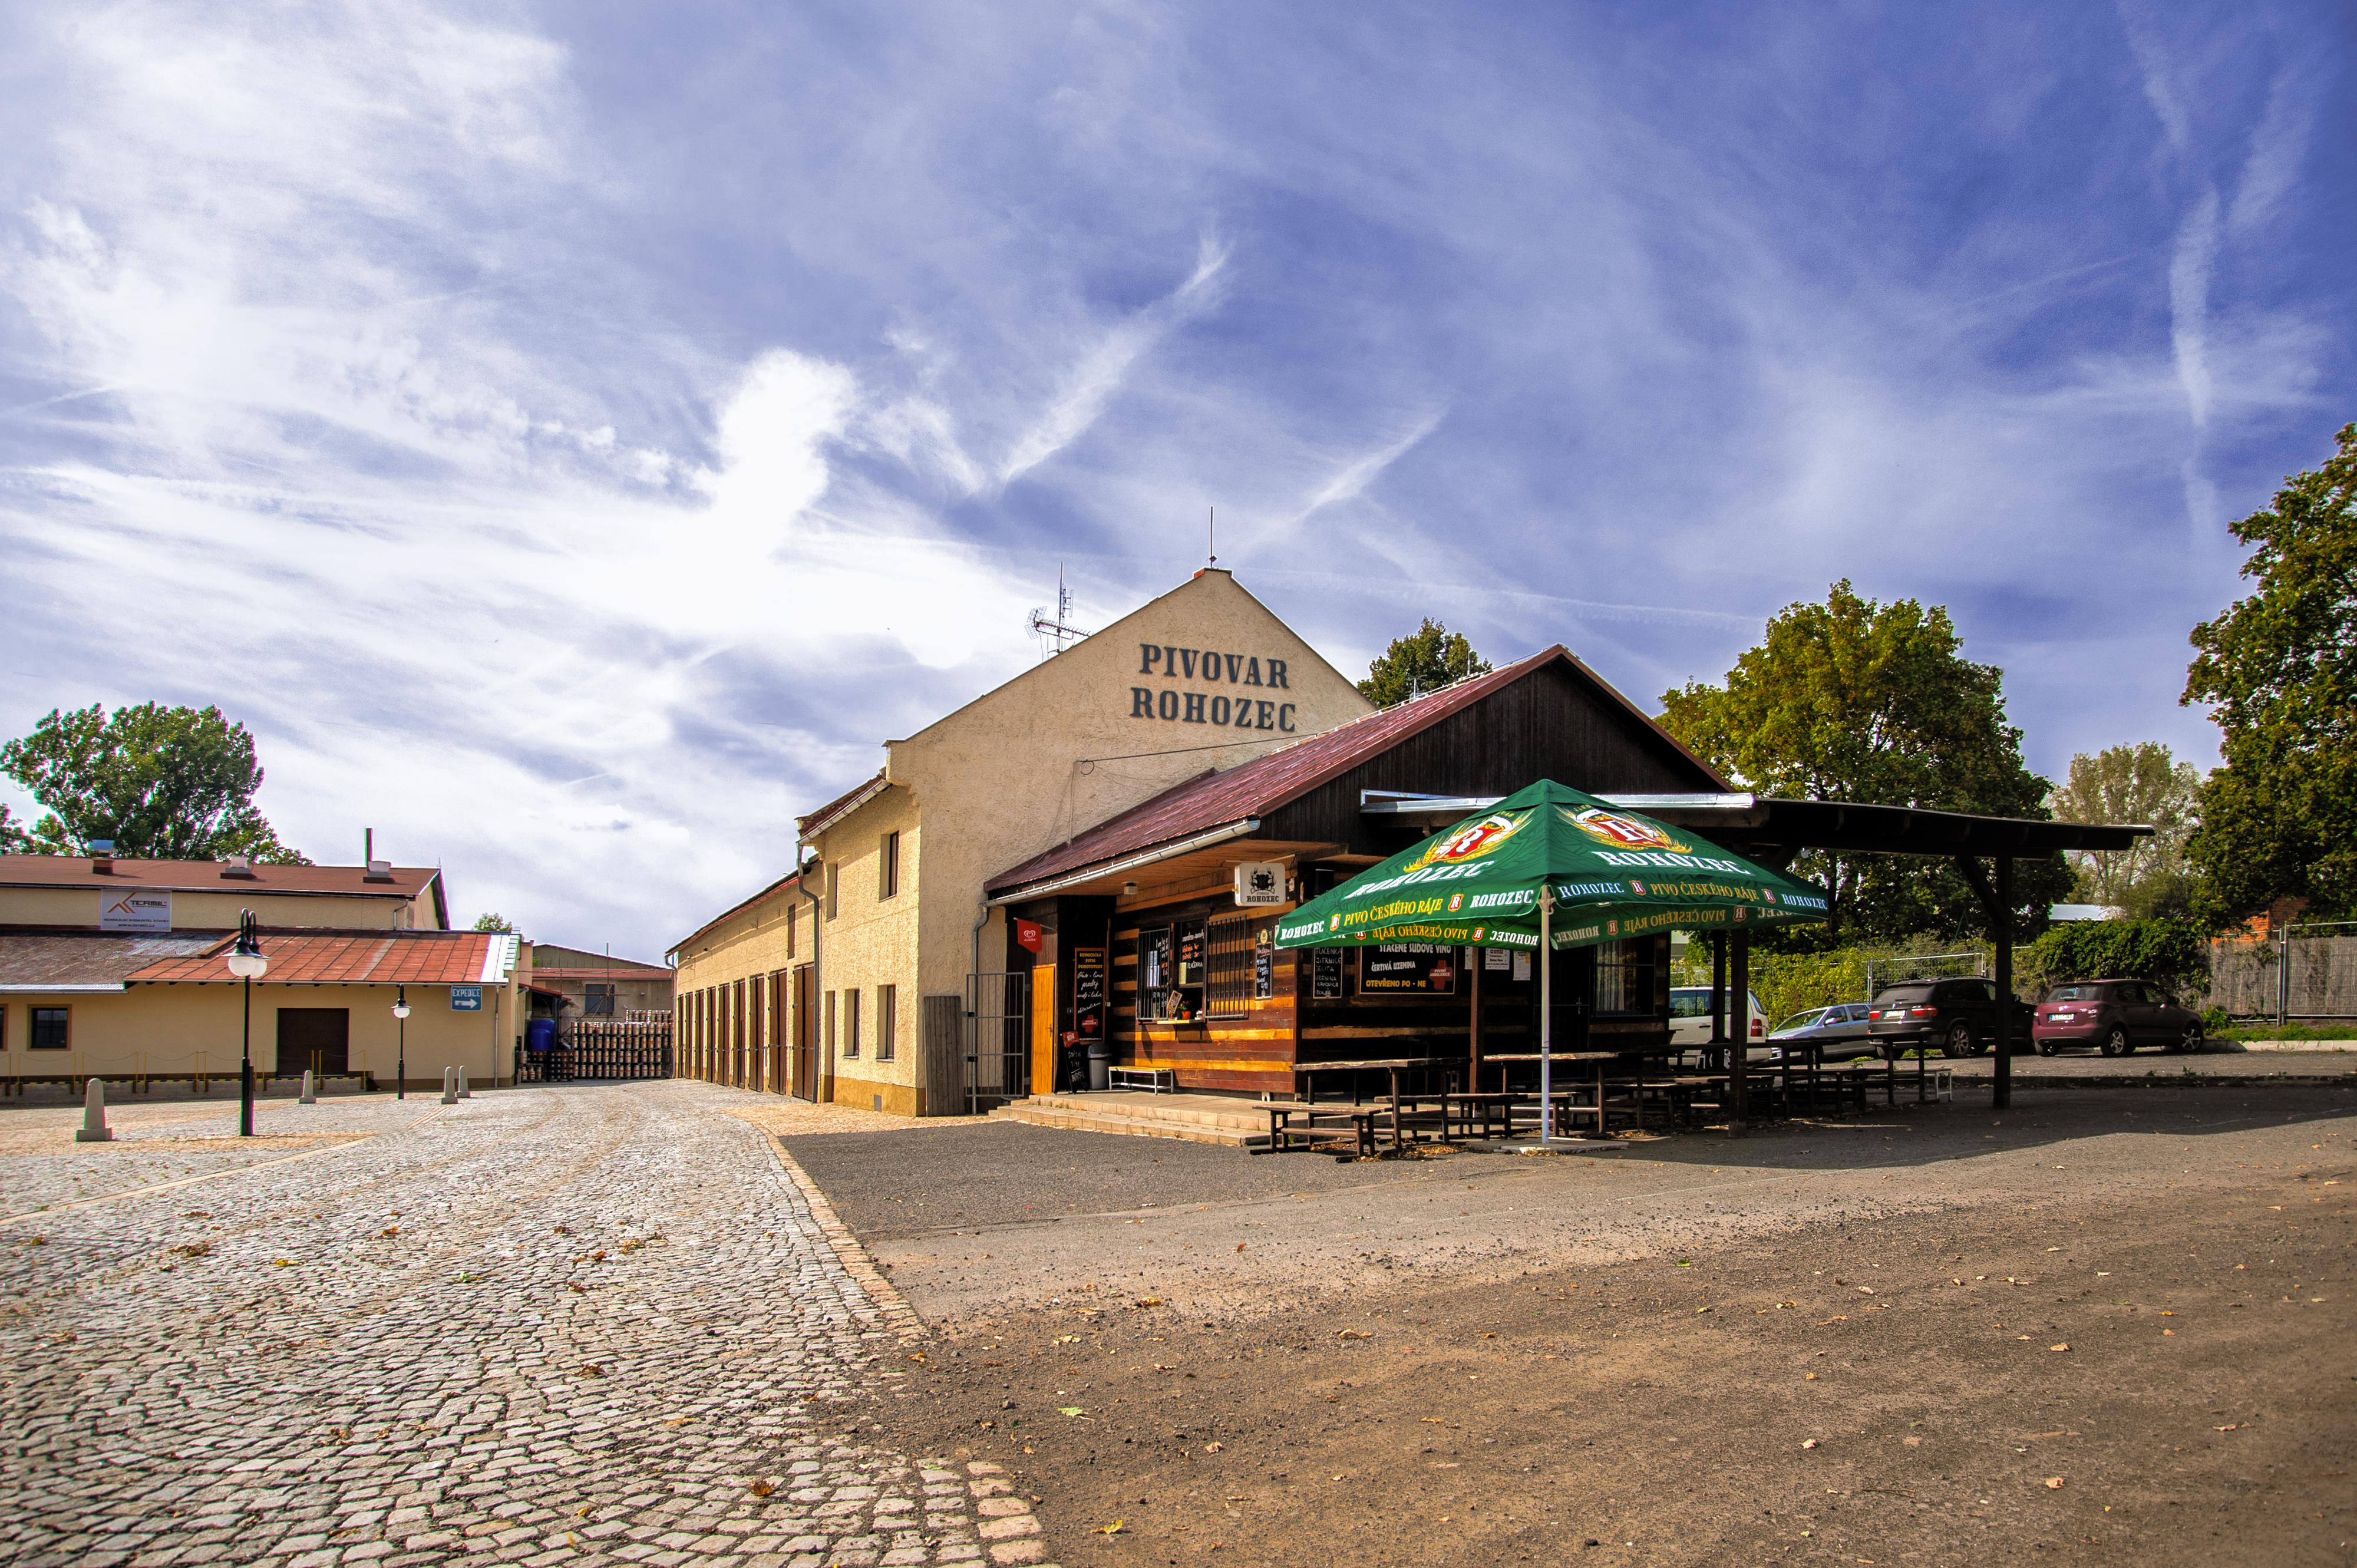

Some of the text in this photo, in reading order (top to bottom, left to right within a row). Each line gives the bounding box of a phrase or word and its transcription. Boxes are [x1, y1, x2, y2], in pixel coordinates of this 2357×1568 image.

[1140, 643, 1289, 688] PIVOVAR
[1130, 687, 1296, 732] ROHOZEC
[1591, 851, 1754, 875] ROHOZEC
[1344, 860, 1495, 899] ROHOZEC
[1558, 883, 1625, 899] ROHOZEC
[1650, 883, 1679, 896] PIVO
[1680, 881, 1734, 897] ČESKÉHO
[1734, 886, 1760, 902] RÁJE
[1780, 893, 1828, 909] ROHOZEC
[1280, 920, 1325, 940] ROHOZEC
[1343, 910, 1368, 926] PIVO
[1370, 900, 1416, 921] ČESKÉHO
[1417, 897, 1443, 915] RÁJE
[1470, 890, 1534, 908] ROHOZEC
[1393, 960, 1416, 970] UZENINA
[453, 988, 481, 997] EXPEDICE
[1366, 978, 1400, 987] OTEVŘENO
